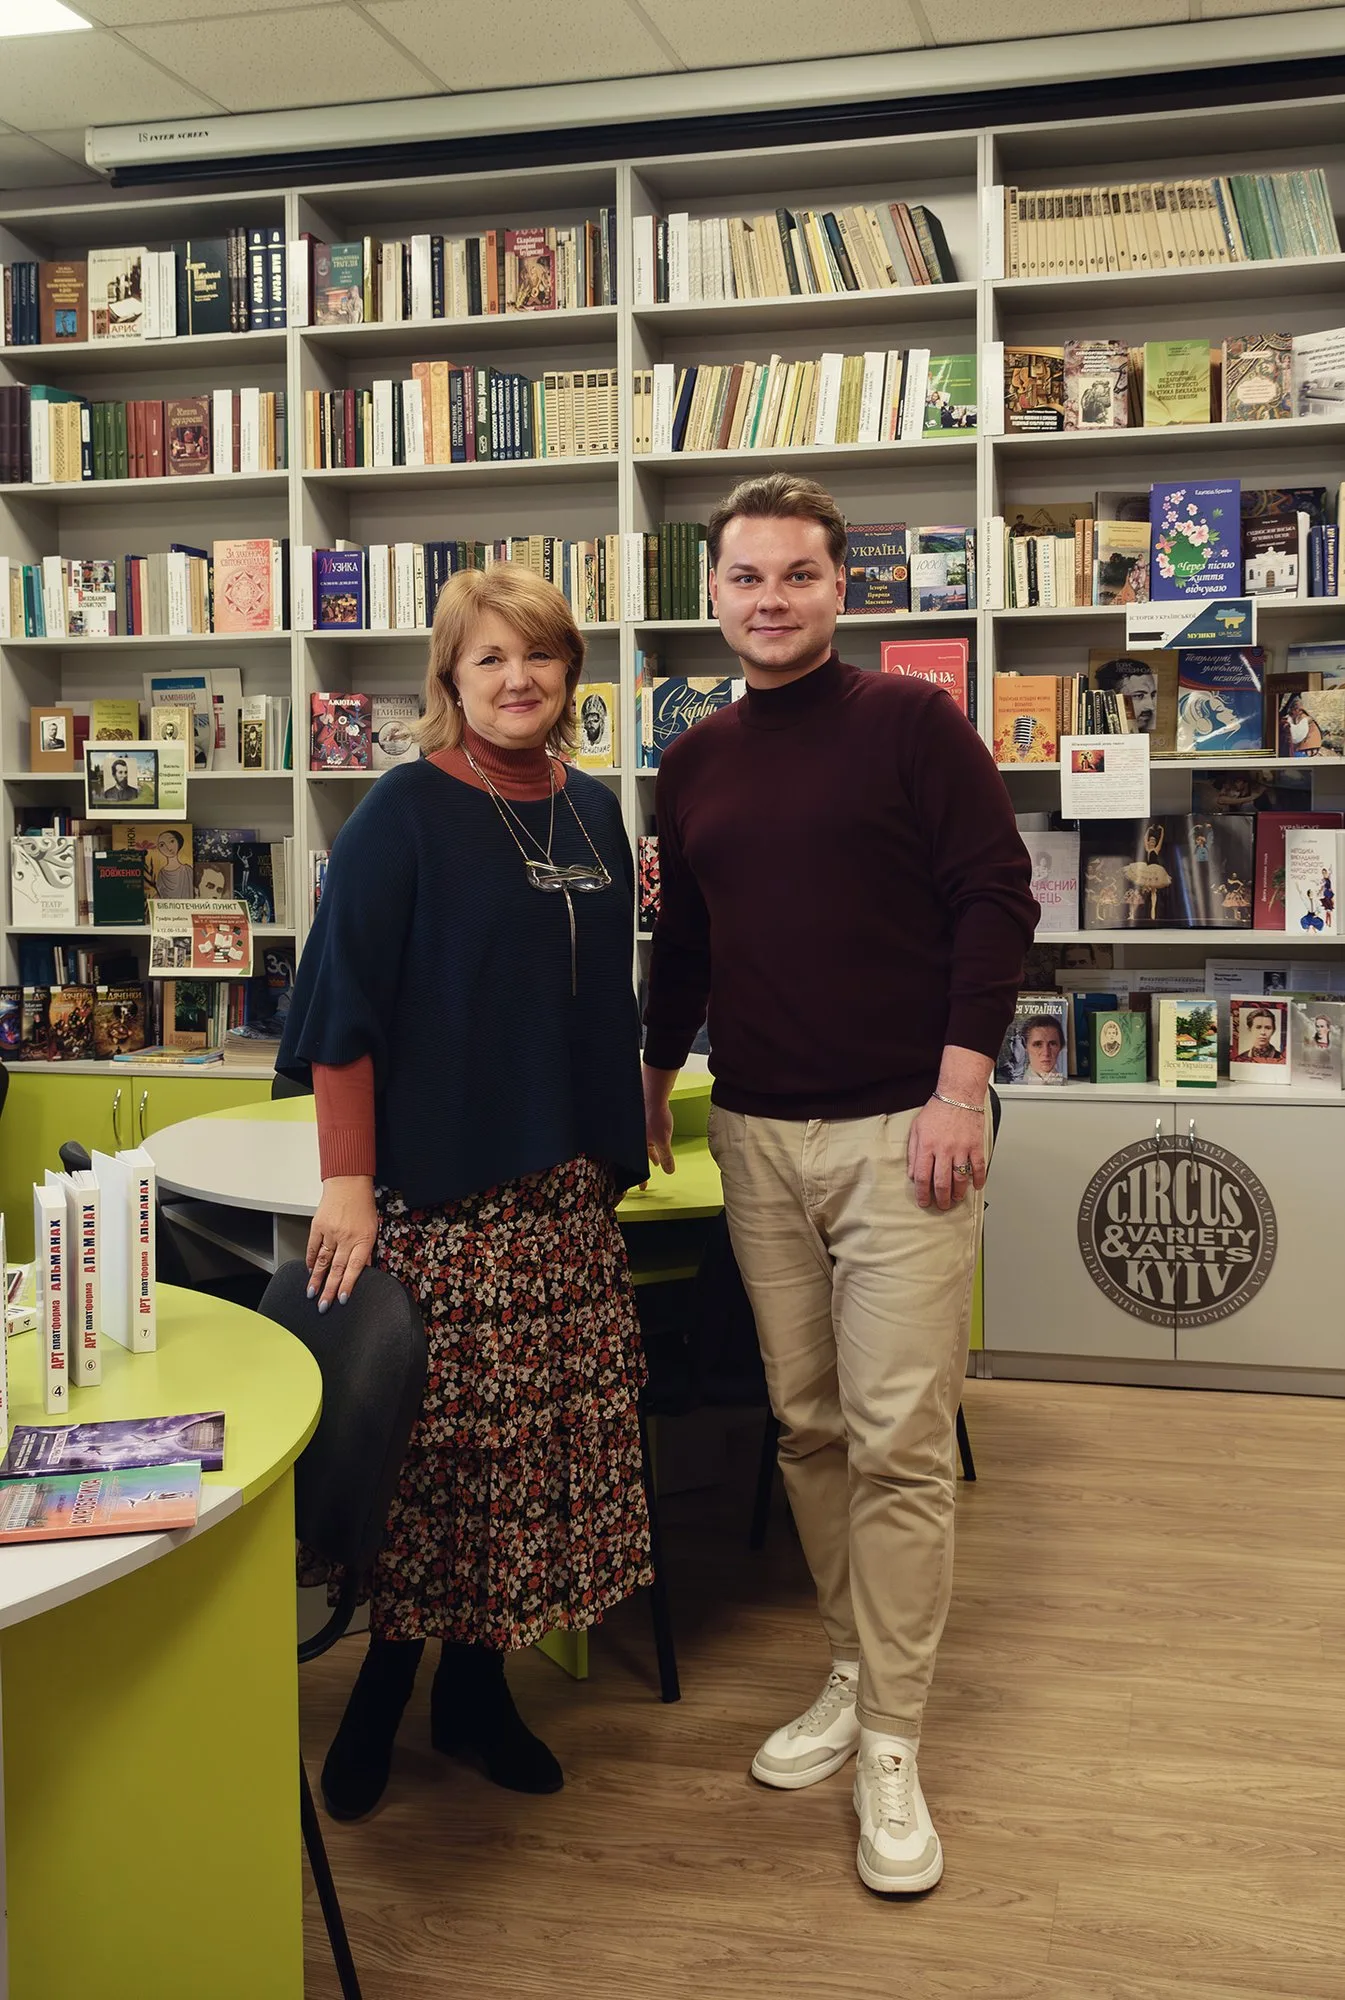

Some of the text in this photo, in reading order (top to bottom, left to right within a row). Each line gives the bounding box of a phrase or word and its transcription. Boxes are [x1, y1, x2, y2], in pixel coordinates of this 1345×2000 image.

[177, 130, 209, 140] SCREEN
[491, 378, 496, 386] 1
[504, 378, 510, 386] 3
[512, 378, 518, 386] 4
[851, 543, 905, 557] УКРАЇНА
[319, 557, 359, 574] МУЗИКА
[916, 559, 941, 571] 1000
[1177, 561, 1236, 573] Через пісню
[1188, 573, 1225, 582] життя
[869, 584, 888, 592] Історія
[1185, 585, 1228, 596] відчуваю
[1155, 612, 1197, 620] УКРАЇНСЬКОЇ
[159, 692, 197, 702] КАМІННИЙ
[376, 708, 413, 717] ГЛИБИН
[99, 868, 141, 878] ДОВЖЕНКО
[1031, 878, 1077, 891] ЧАСНИЙ
[41, 900, 63, 908] ТЕАТР
[156, 901, 238, 910] БІБЛІОТЕЧНИЙ ПУНКТ
[107, 992, 142, 1000] ДЯЧЕНКИ
[1015, 1003, 1063, 1015] СЯ УКРАЇНКА
[1137, 1137, 1227, 1159] АКАДЕМІЯ
[1080, 1152, 1130, 1222] КИЇВСЬКА
[1106, 1159, 1243, 1227] CIRCUS
[1231, 1160, 1276, 1262] ЕСТРАДНОГО
[139, 1179, 151, 1314] АРТ платформа АЛЬМАНАХ
[1100, 1224, 1256, 1258] & VARIETY
[1131, 1244, 1254, 1263] ARTS
[83, 1204, 97, 1349] АРТ платформа АЛЬМАНАХ
[1125, 1260, 1236, 1305] KYIV
[50, 1219, 65, 1370] АРТ платформа АЛЬМАНАХ
[1150, 1290, 1250, 1326] ЦИРКОВОГО
[142, 1329, 148, 1337] 7
[87, 1360, 94, 1370] 6
[54, 1386, 63, 1397] 4
[69, 1477, 104, 1525] АКРОБАТИКА
